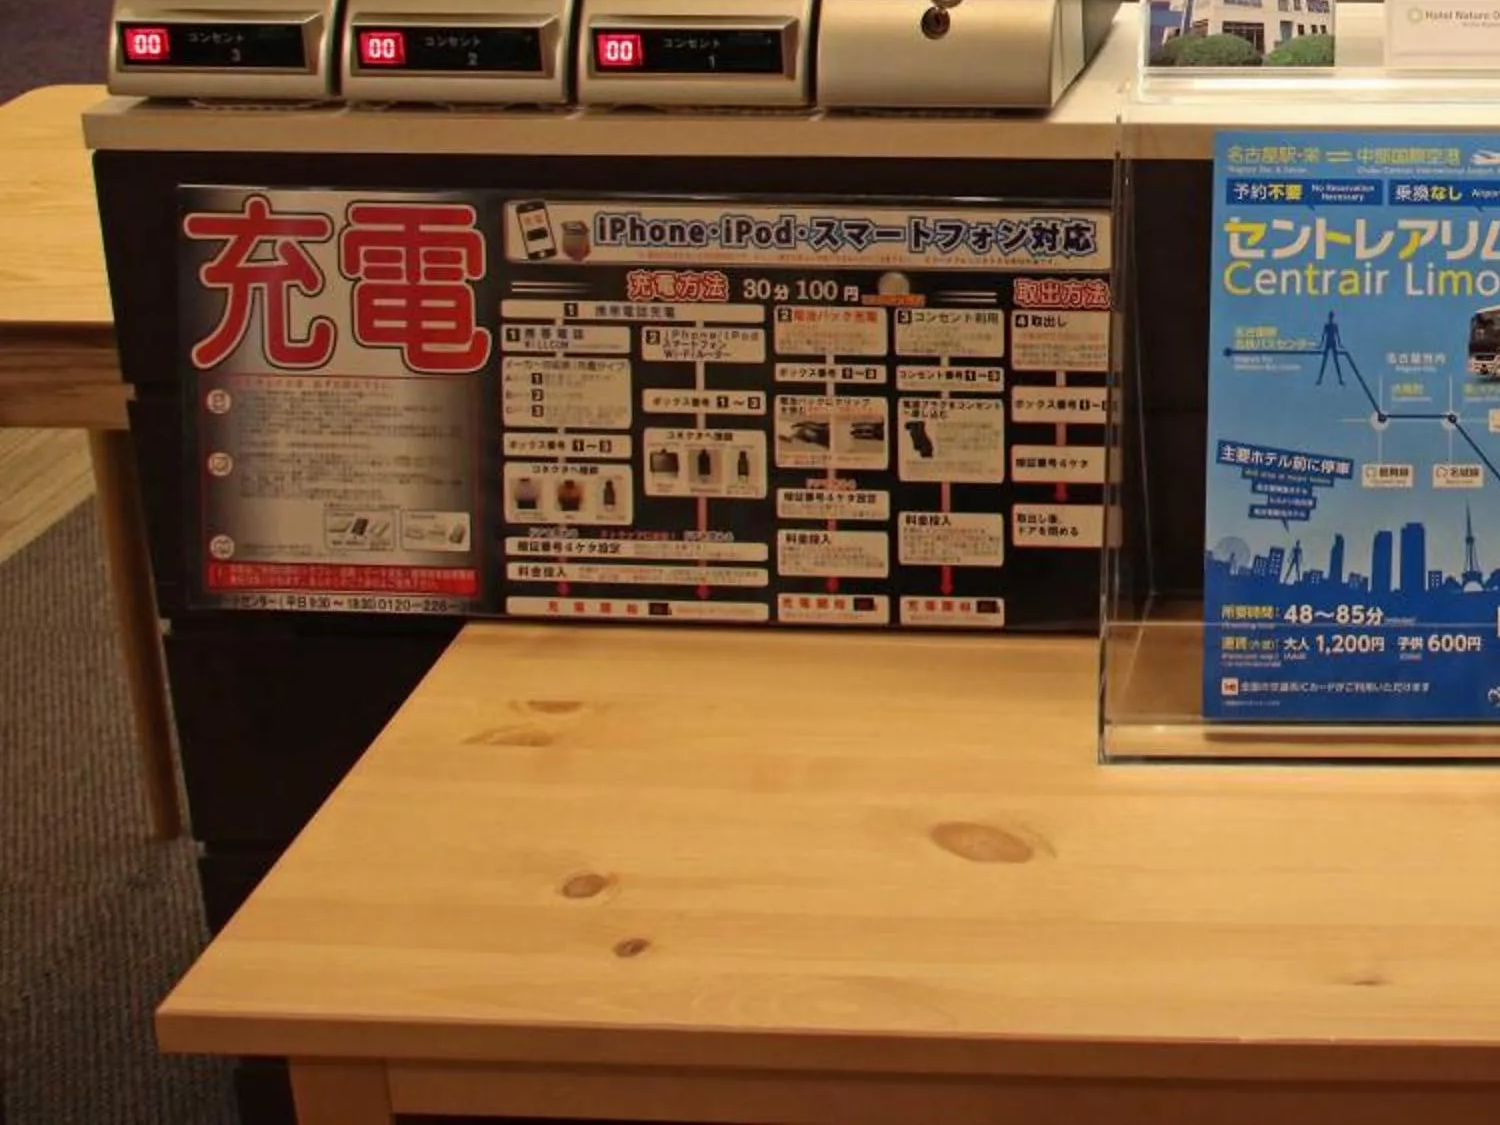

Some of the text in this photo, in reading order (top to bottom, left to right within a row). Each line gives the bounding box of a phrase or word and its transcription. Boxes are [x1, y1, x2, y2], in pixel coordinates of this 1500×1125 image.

[134, 34, 161, 56] 00
[368, 37, 395, 59] 00
[605, 39, 633, 62] 00
[1233, 183, 1304, 201] 予約不要
[1395, 183, 1463, 202] 乗換なし
[184, 195, 492, 373] 充電
[627, 271, 730, 303] 充電方法
[1223, 261, 1390, 296] Centrair
[1012, 277, 1112, 309] 取出方法
[1031, 314, 1067, 328] 取出し
[1220, 444, 1351, 475] 主要ホテル前に停車
[1283, 604, 1385, 626] 48～85分
[1283, 635, 1482, 655] 大人 1,200円 子供 600円
